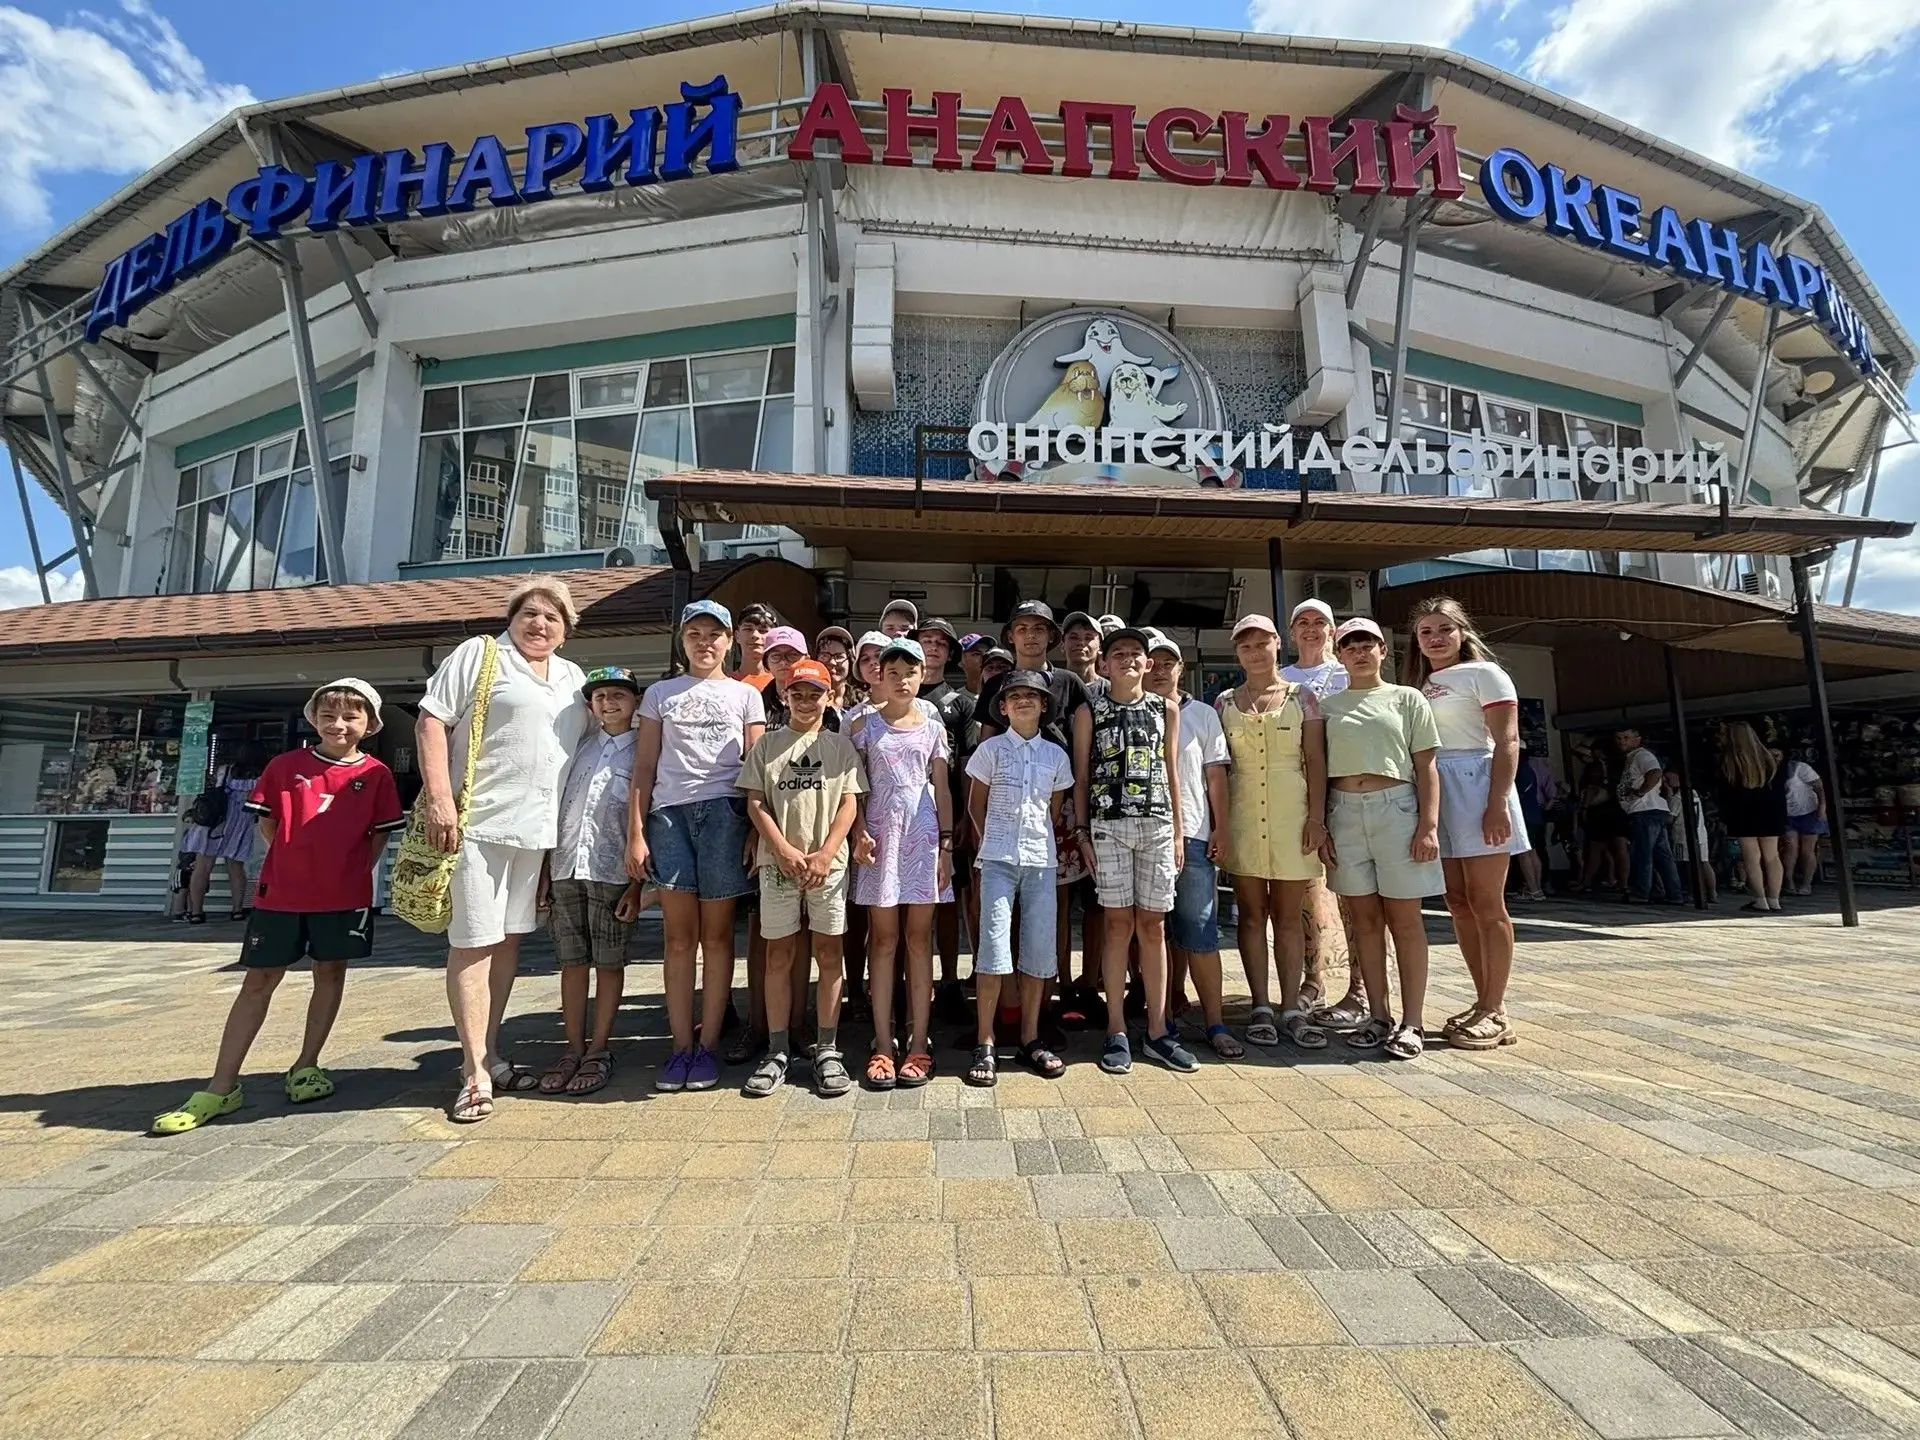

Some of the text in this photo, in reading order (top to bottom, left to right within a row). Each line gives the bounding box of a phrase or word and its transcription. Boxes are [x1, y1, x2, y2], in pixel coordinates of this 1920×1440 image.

[84, 75, 743, 344] ДЕЛЬФИНАРИЙ
[788, 82, 1466, 199] АНАПСКИЙ
[316, 793, 335, 813] 7
[355, 908, 369, 929] 7
